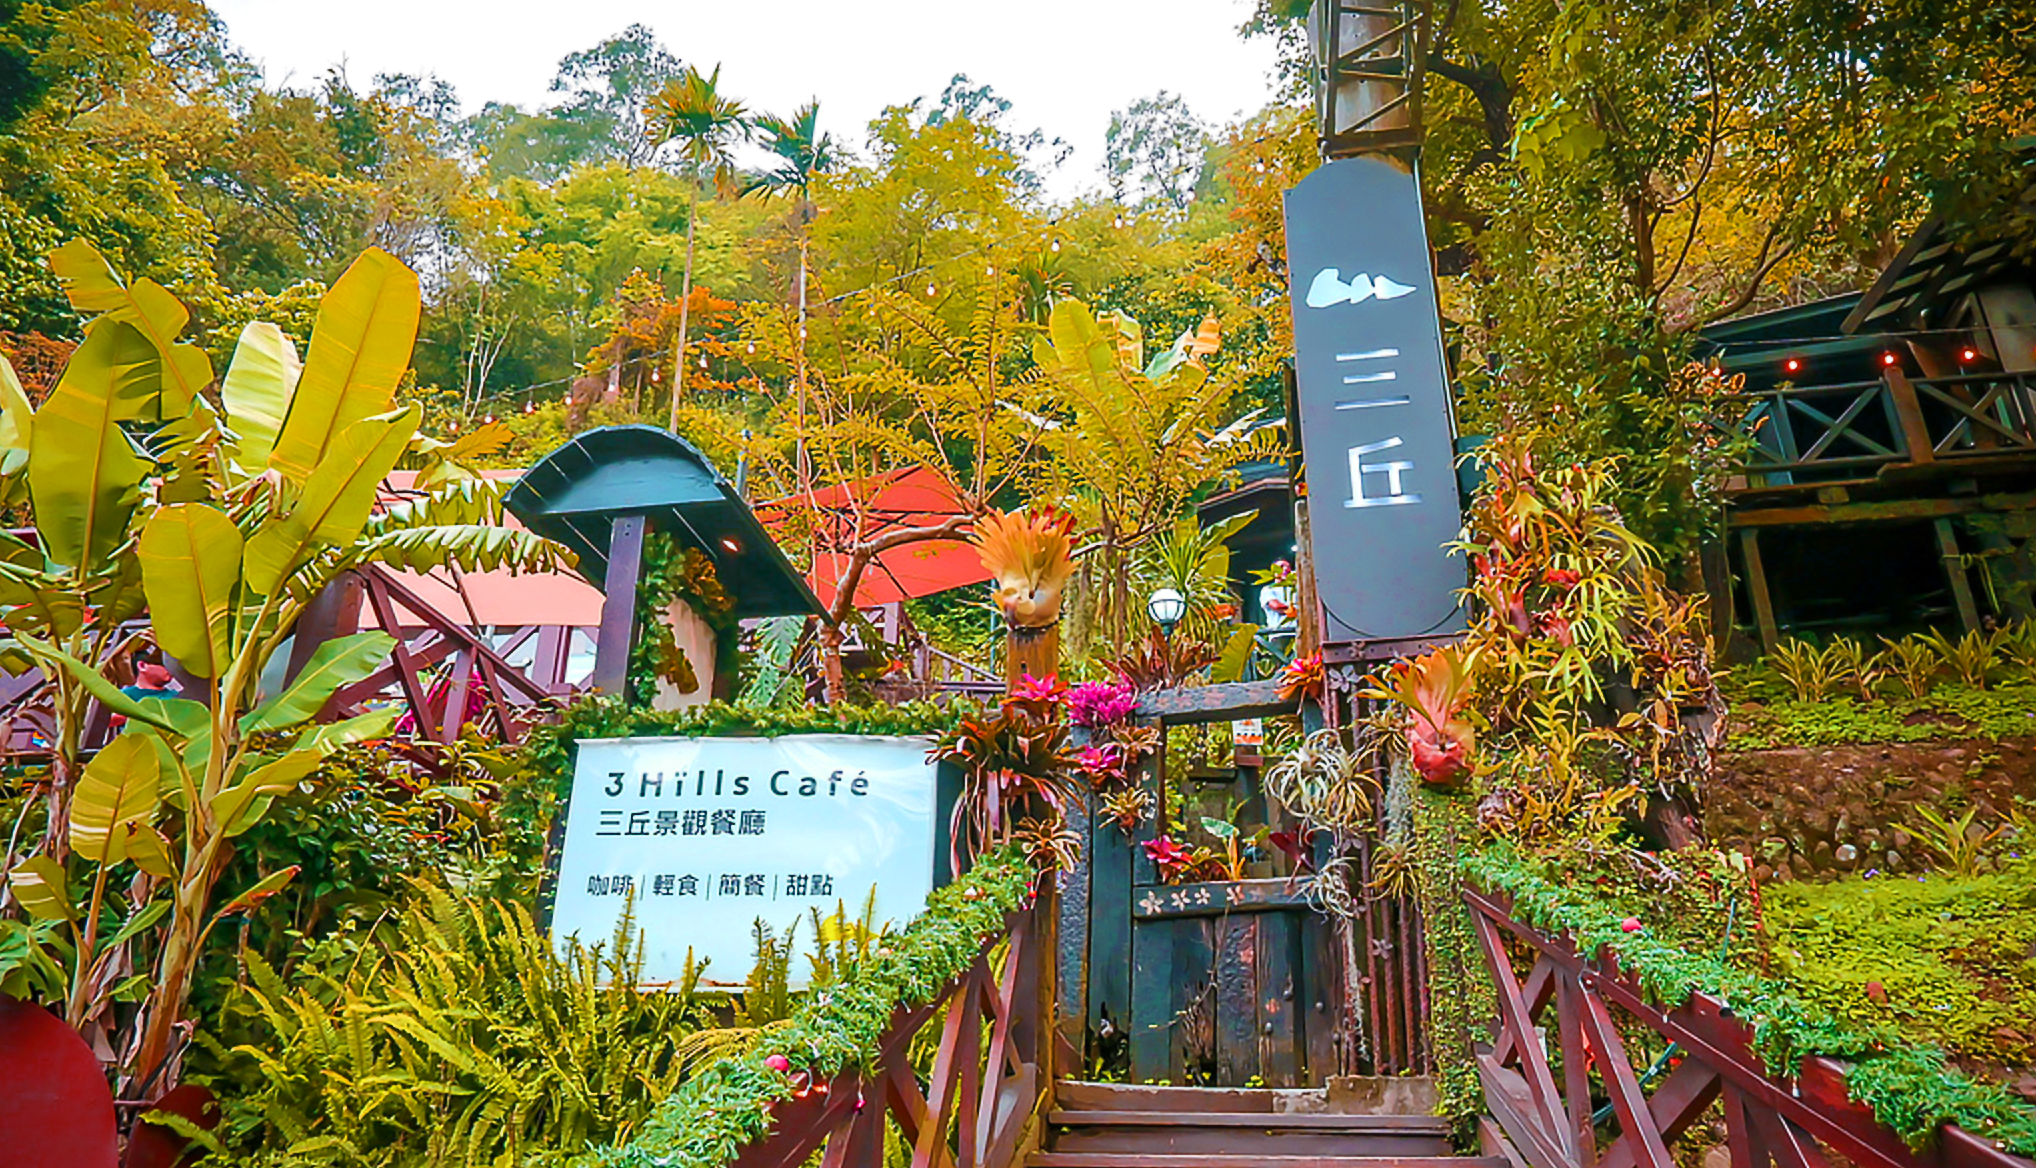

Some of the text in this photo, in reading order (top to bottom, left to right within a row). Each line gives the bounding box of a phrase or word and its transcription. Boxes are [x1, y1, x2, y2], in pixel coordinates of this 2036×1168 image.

[1334, 349, 1422, 508] 三丘
[605, 772, 624, 797] 3
[770, 770, 869, 796] Café
[596, 809, 766, 836] 三丘景觀餐廳
[653, 874, 699, 896] 輕食
[719, 874, 765, 896] 簡餐
[786, 874, 833, 896] 甜點
